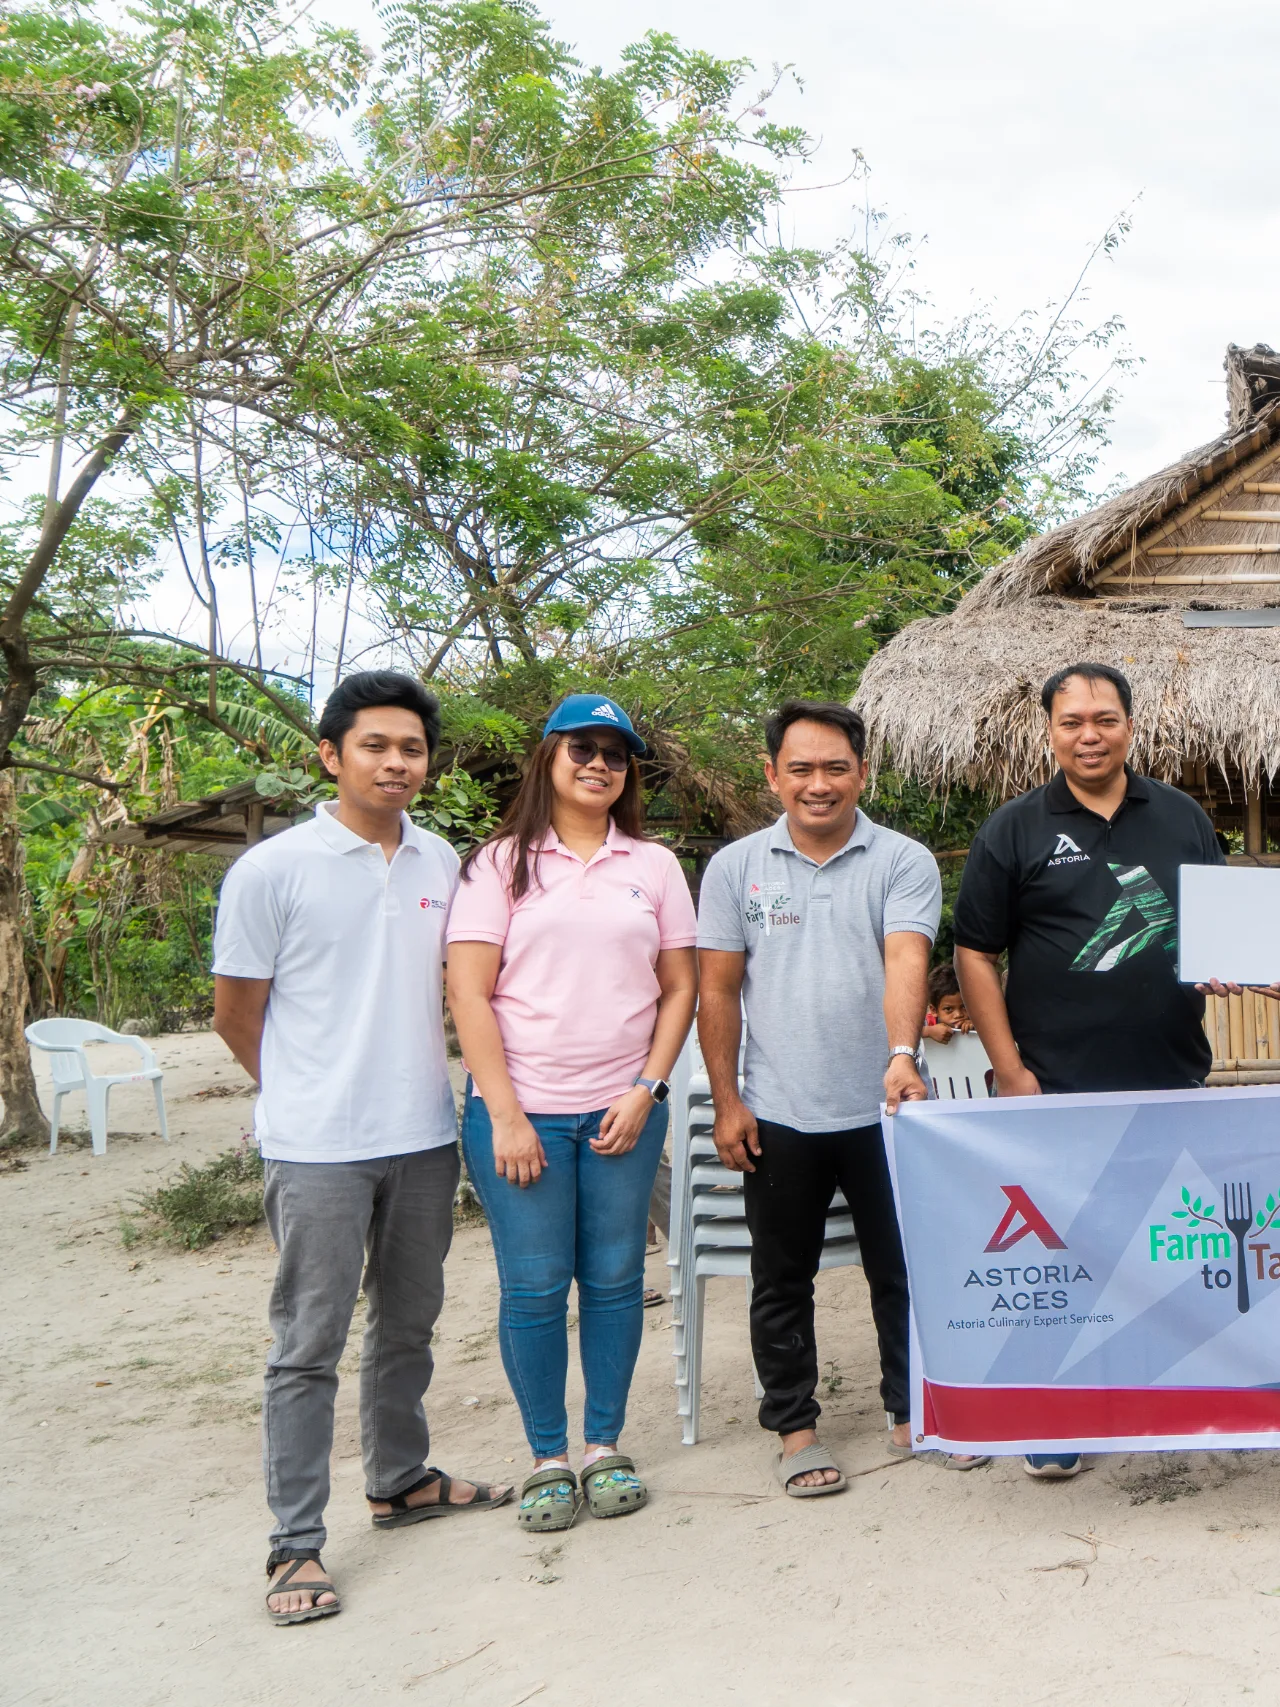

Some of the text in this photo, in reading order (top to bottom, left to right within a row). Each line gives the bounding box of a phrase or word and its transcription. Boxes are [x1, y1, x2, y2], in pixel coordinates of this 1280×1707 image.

[1047, 853, 1091, 867] ASTORIA
[769, 912, 800, 926] Table
[1149, 1224, 1231, 1263] Farm
[1201, 1264, 1232, 1290] to
[963, 1264, 1093, 1288] ASTORIA
[990, 1290, 1069, 1312] ACES
[947, 1313, 1114, 1331] Astoria Culinary Expert Services
